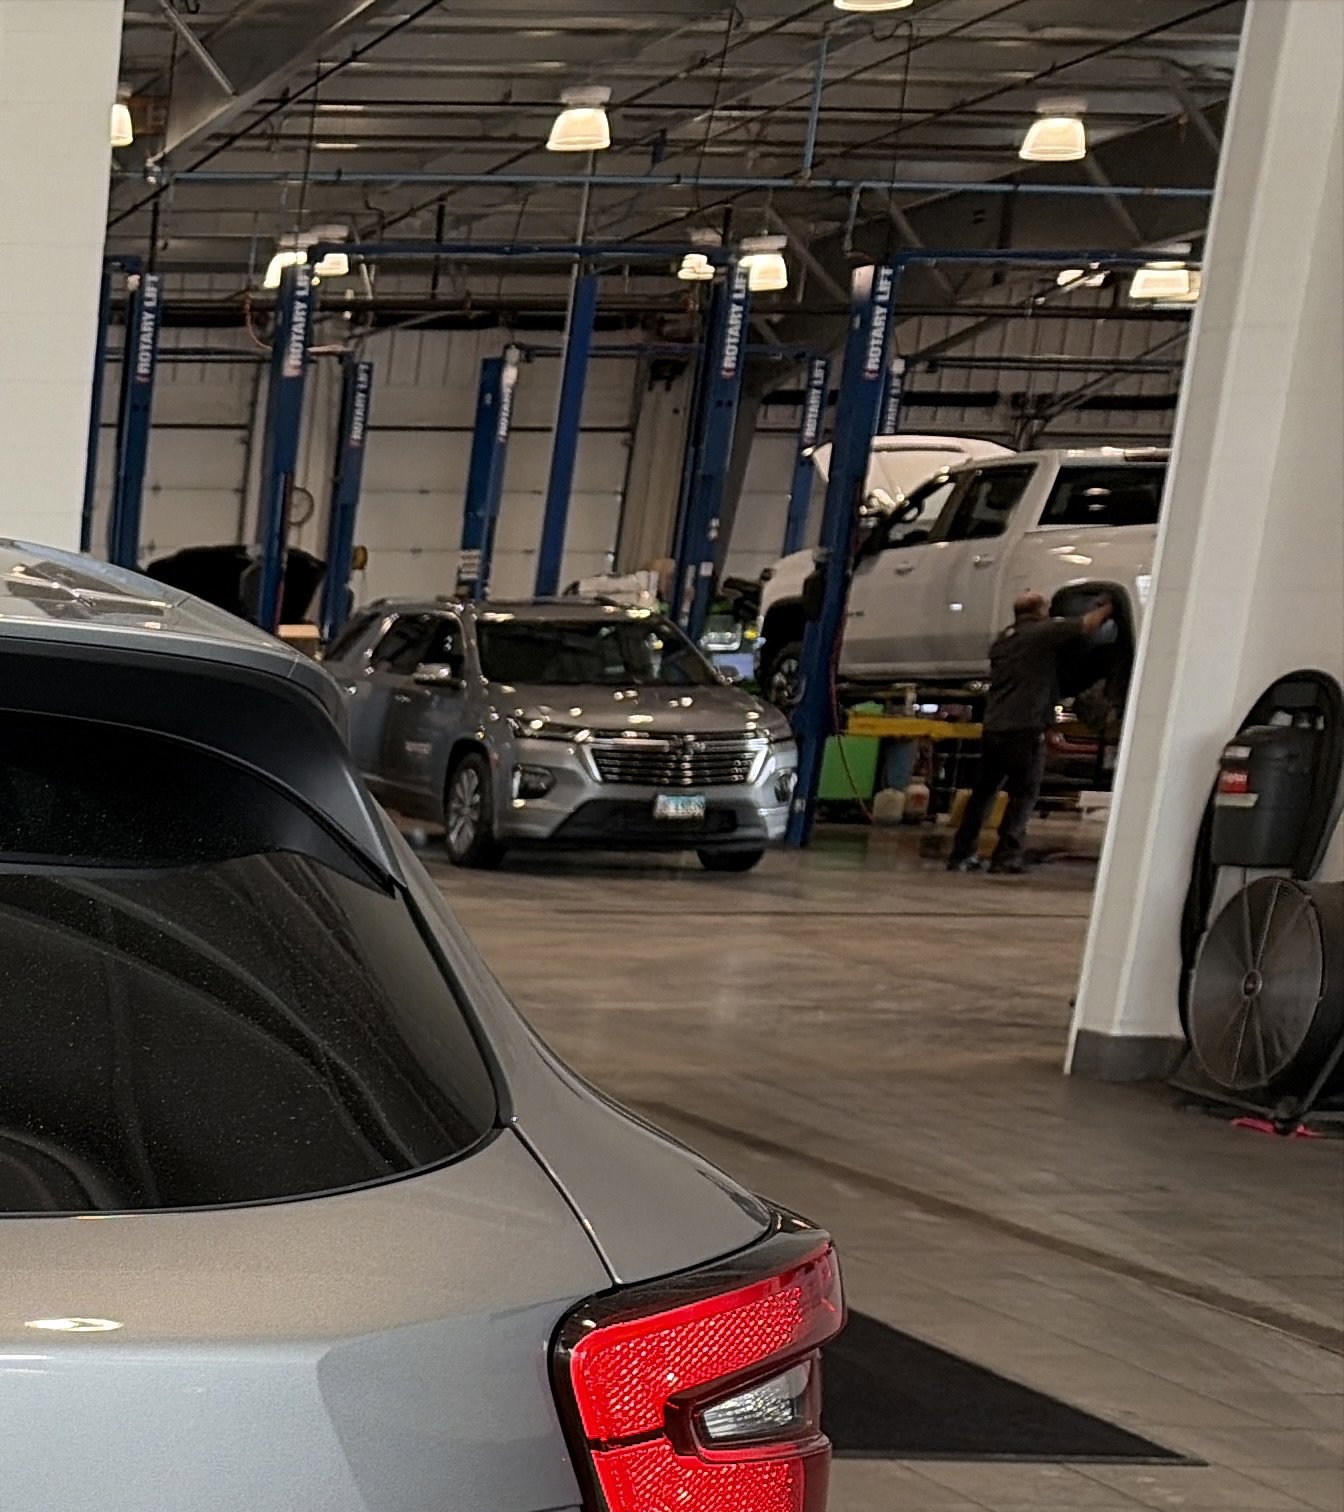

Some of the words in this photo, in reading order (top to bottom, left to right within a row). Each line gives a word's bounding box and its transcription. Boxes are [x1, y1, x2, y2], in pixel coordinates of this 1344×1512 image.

[143, 273, 160, 307] LIFT
[876, 264, 894, 302] LIFT
[136, 311, 156, 374] ROTARY
[723, 302, 745, 370] ROTARY
[866, 304, 889, 371] ROTARY
